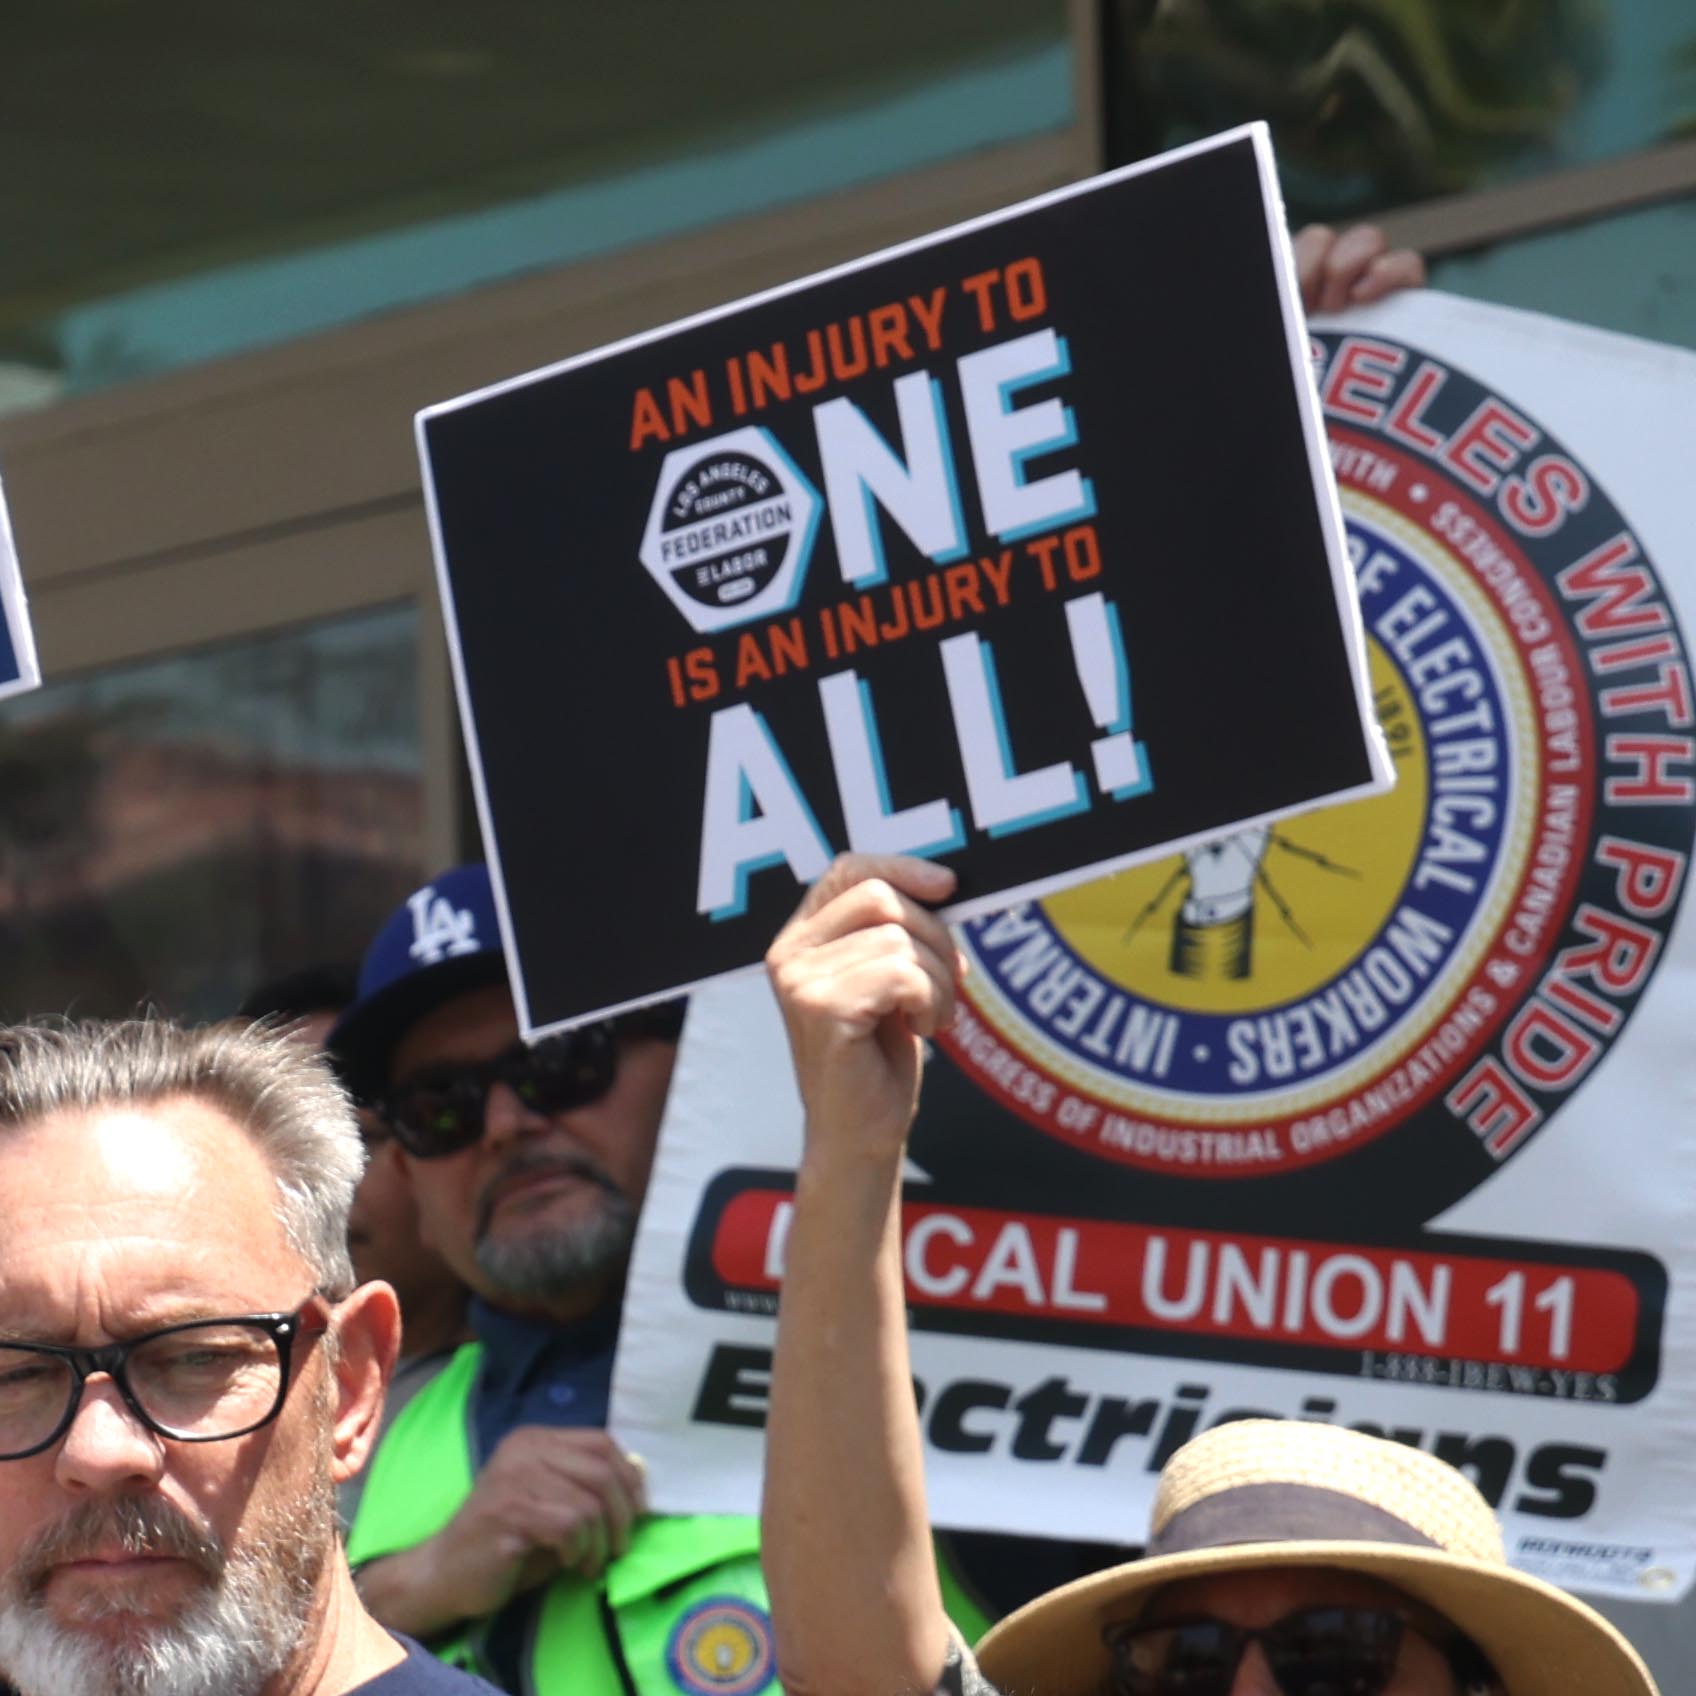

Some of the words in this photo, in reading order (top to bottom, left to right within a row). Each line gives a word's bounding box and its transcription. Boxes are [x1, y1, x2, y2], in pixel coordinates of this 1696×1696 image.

[629, 372, 711, 452] AN
[727, 288, 949, 419] INJURY
[962, 256, 1047, 335] TO
[661, 502, 792, 563] FEDERATION
[673, 480, 700, 519] LOS
[698, 461, 771, 497] ANGELES
[709, 549, 768, 583] LABOR
[668, 644, 722, 708] IS
[735, 620, 810, 692] AN
[818, 555, 1014, 662] INJURY
[1027, 526, 1102, 592] TO
[1429, 500, 1553, 645] CONGRESS
[1374, 585, 1499, 897] ELECTRICAL
[1529, 627, 1582, 774] LABOUR
[1555, 529, 1696, 806] WITH
[697, 592, 1154, 922] ALL!
[409, 886, 481, 963] LA
[1505, 783, 1578, 956] CANADIAN
[1226, 906, 1455, 1086] WORKERS
[1446, 834, 1686, 1161] PRIDE
[1485, 957, 1522, 992] &
[1054, 1094, 1104, 1135] OF
[1100, 1110, 1284, 1164] INDUSTRIAL
[1289, 987, 1499, 1153] ORGANIZATIONS
[764, 1197, 1106, 1313] LCAL
[1141, 1235, 1452, 1348] UNION
[1484, 1274, 1579, 1361] 11
